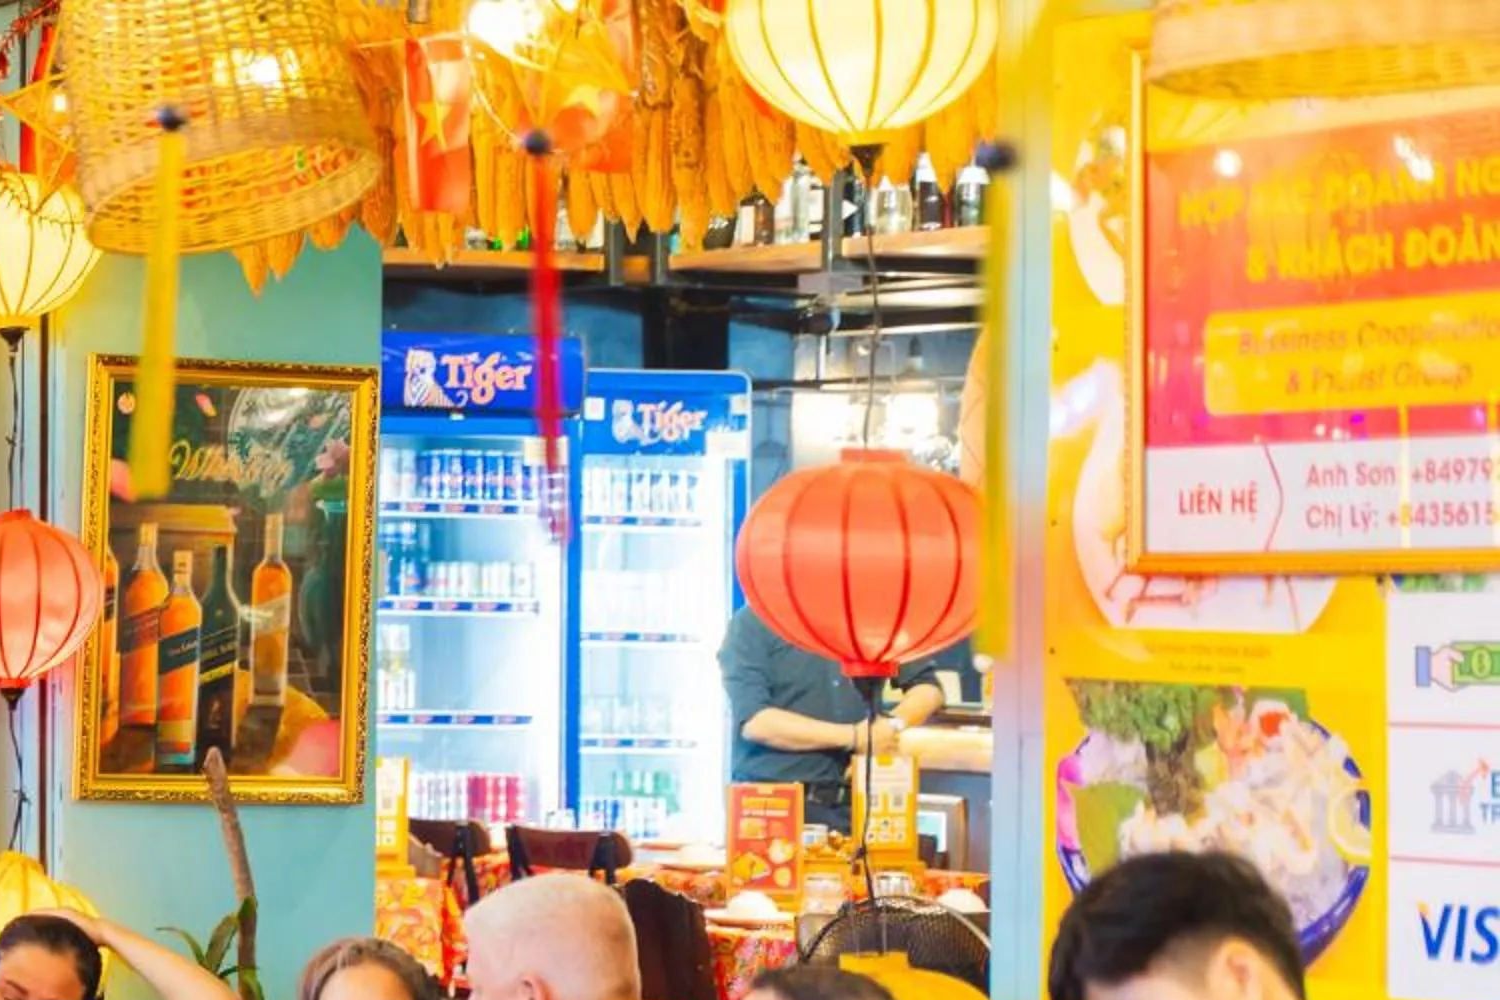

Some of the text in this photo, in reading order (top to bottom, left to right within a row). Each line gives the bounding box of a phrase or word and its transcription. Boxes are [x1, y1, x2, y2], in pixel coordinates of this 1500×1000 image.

[440, 351, 533, 405] Tiger
[637, 400, 708, 443] Tiger
[1306, 463, 1348, 488] Anh
[1411, 455, 1500, 484] +84979
